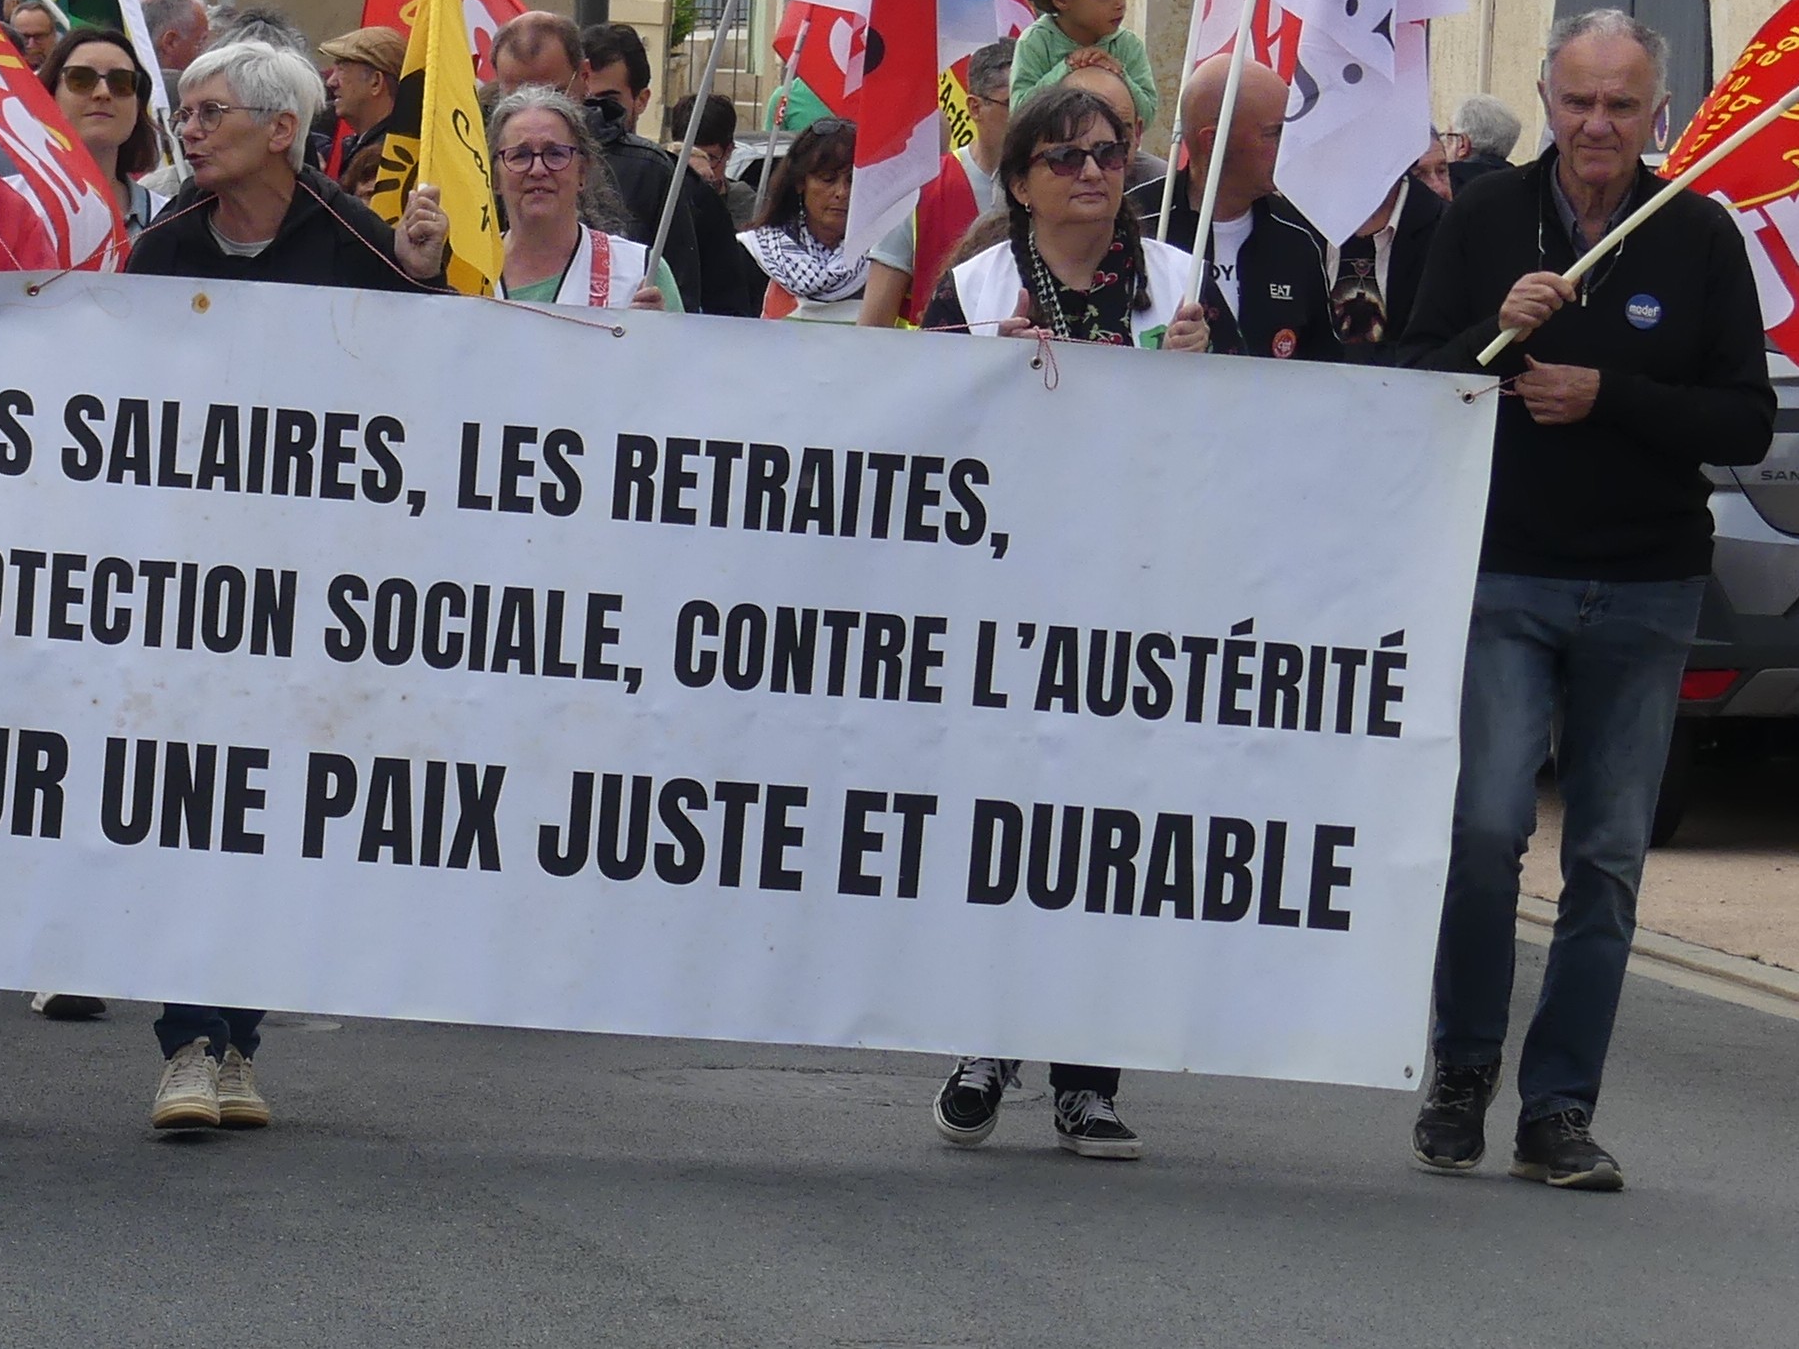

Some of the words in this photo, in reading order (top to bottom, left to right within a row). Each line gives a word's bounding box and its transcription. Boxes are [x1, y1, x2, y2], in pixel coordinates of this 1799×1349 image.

[1269, 283, 1292, 297] EA7
[61, 394, 427, 517] SALAIRES,
[457, 421, 584, 517] LES
[611, 433, 1009, 560] RETRAITES,
[324, 573, 643, 695] SOCIALE,
[674, 599, 948, 704] CONTRE
[972, 616, 1409, 739] L'AUSTÉRITÉ
[101, 736, 270, 855] UNE
[301, 752, 507, 872] PAIX
[537, 770, 809, 892] JUSTE
[837, 789, 939, 899] ET
[966, 798, 1356, 932] DURABLE
